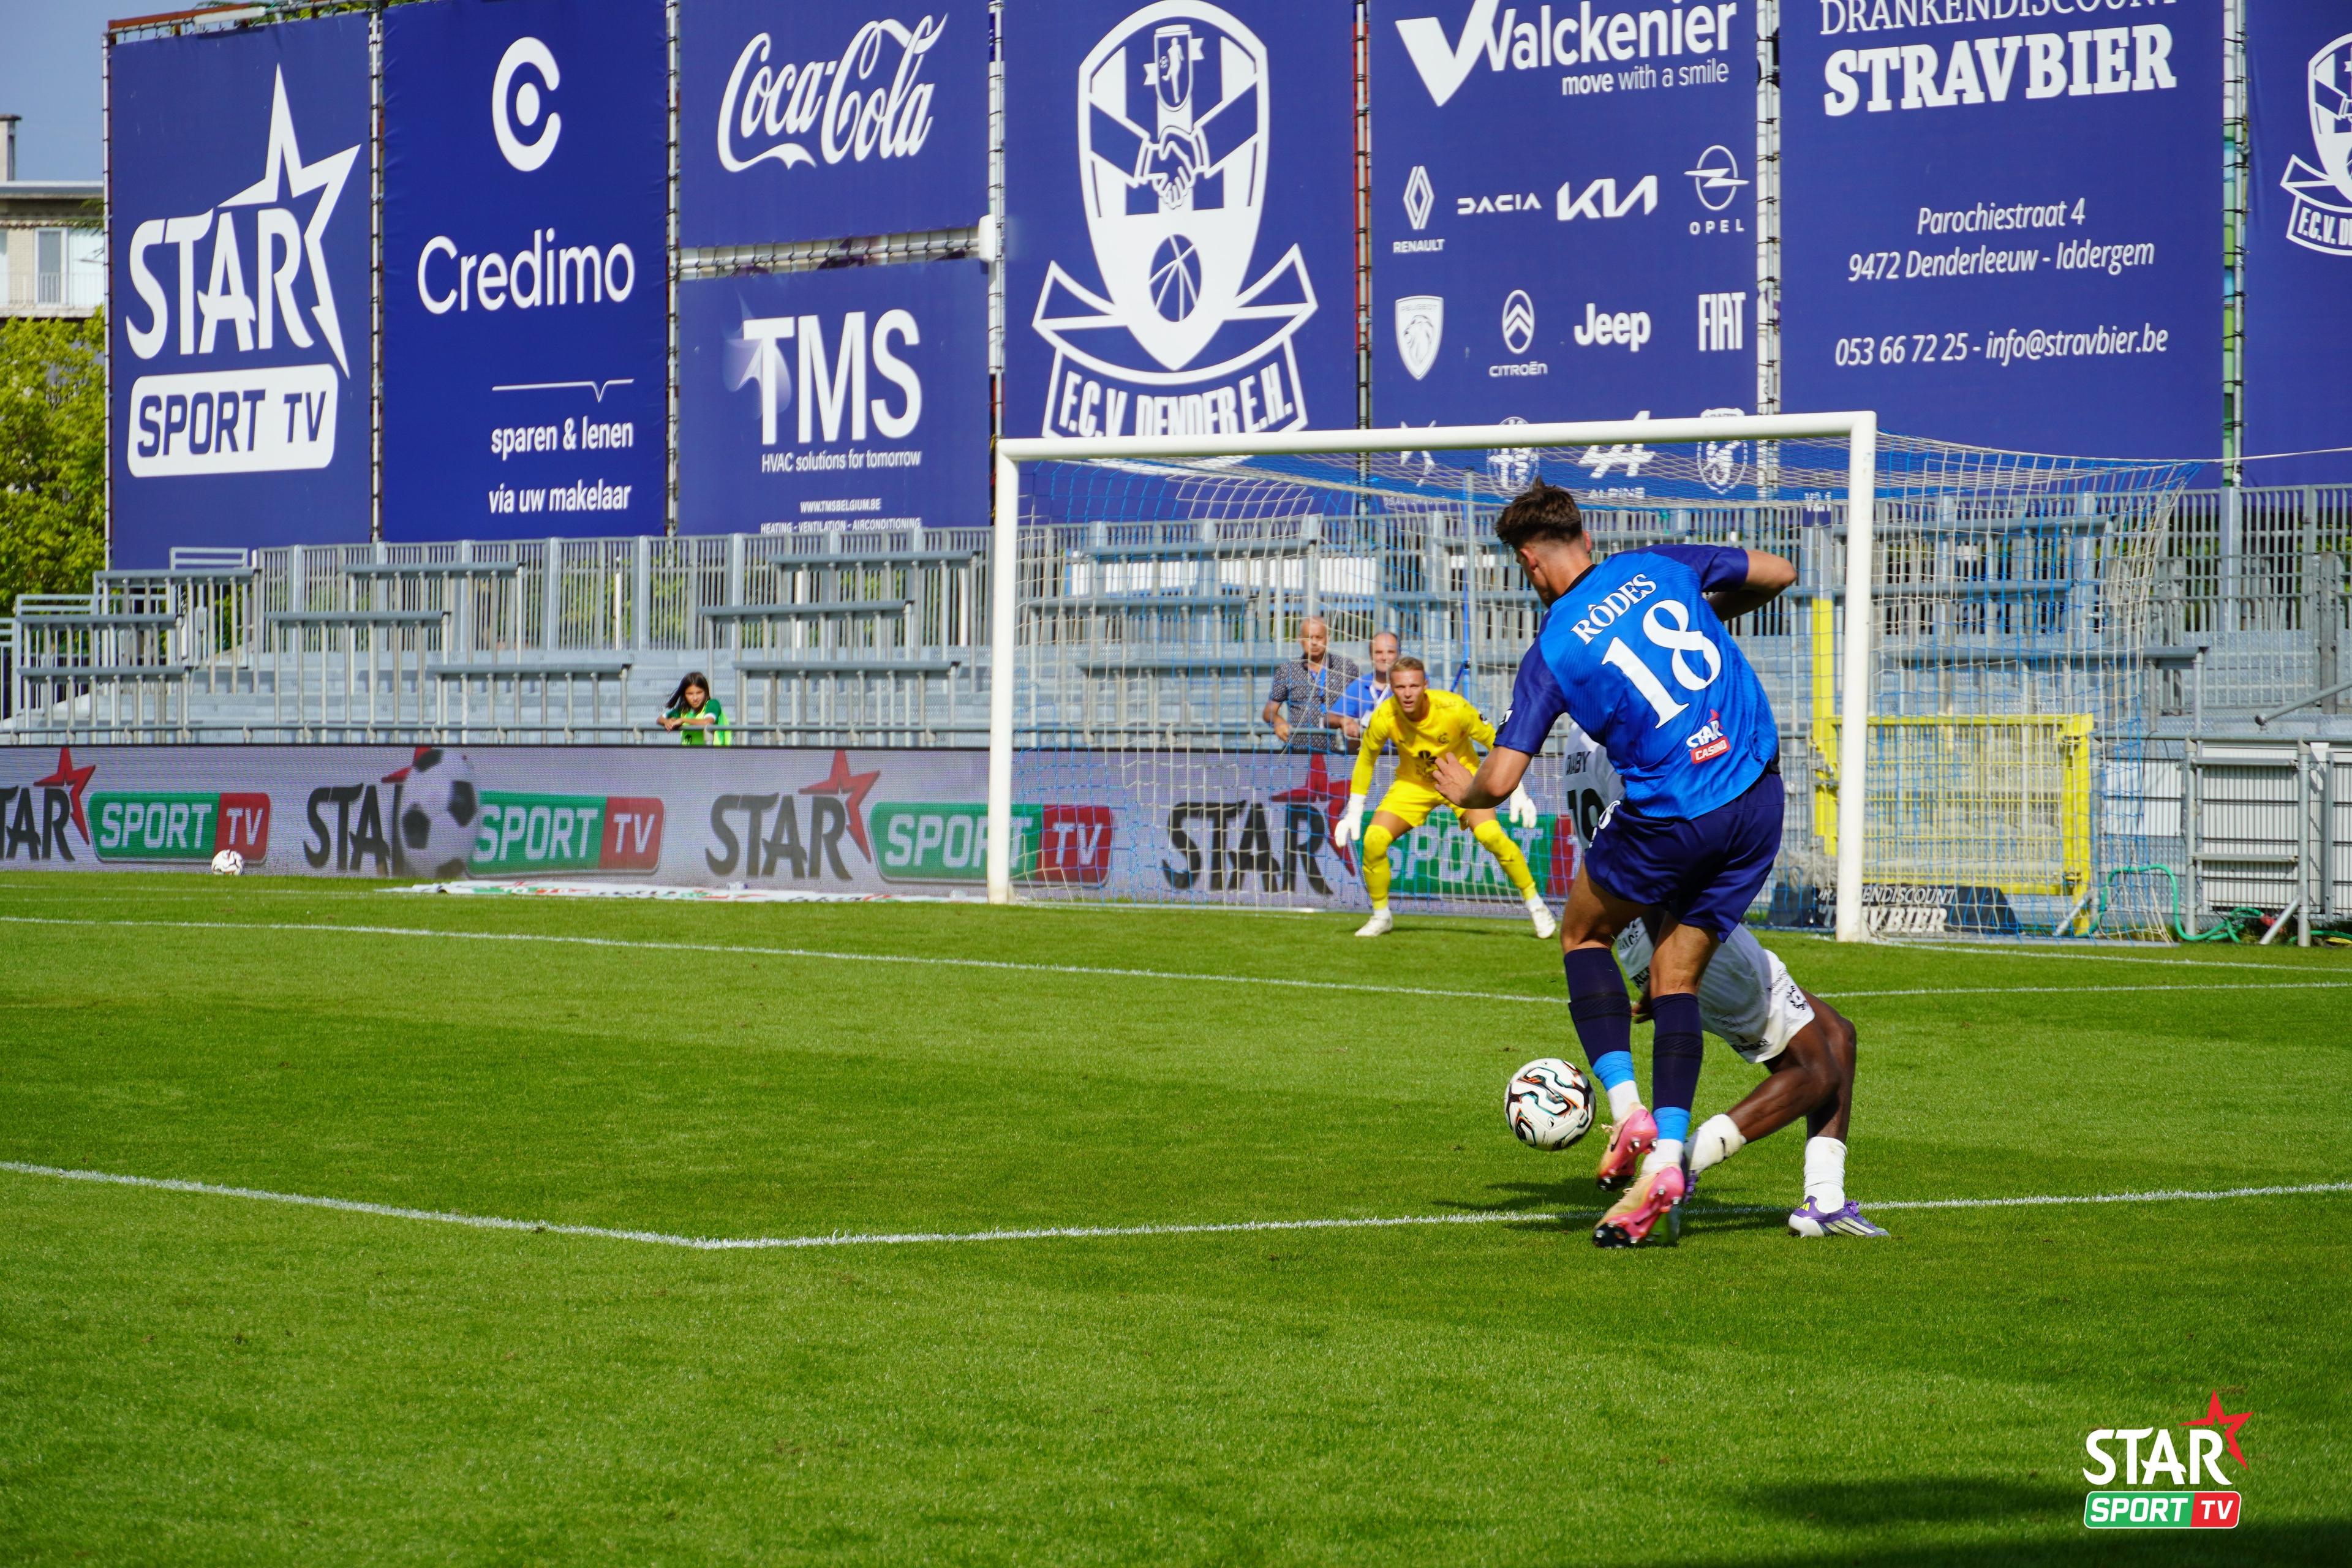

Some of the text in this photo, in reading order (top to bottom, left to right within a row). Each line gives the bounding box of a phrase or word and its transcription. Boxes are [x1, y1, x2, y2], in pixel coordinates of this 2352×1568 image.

[1395, 0, 1737, 107] Walckenier
[1562, 58, 1729, 96] move with a smile
[1824, 24, 2177, 116] STRAVBIER
[718, 13, 948, 172] Coca-Cola
[1457, 192, 1542, 215] DACIA
[1557, 175, 1657, 221] KIA
[1917, 197, 2086, 235] Parochiestraat 4
[1393, 238, 1445, 254] RENAULT
[1689, 219, 1745, 235] OPEL
[126, 208, 315, 360] STAR
[418, 228, 635, 314] Credimo
[1848, 252, 1901, 282] 9472
[1905, 245, 2039, 278] Denderleeuw
[2056, 239, 2155, 276] Iddergem
[1574, 303, 1651, 352] Jeep
[1698, 292, 1746, 352] FIAT
[1835, 337, 1875, 366] 053
[1879, 335, 1907, 364] 66
[1912, 334, 1937, 363] 72
[1941, 333, 1969, 361] 25
[1986, 323, 2168, 366] info@stravbier.be
[743, 309, 922, 445] TMS
[137, 389, 326, 458] SPORT TV
[1059, 371, 1128, 437] F.C.V
[491, 416, 633, 461] sparen & lenen
[761, 448, 921, 473] HVAC solutions for tomorrow
[489, 478, 631, 513] via uw makelaar
[800, 498, 881, 513] WWW.TMSBELGIUM.BE
[760, 522, 792, 534] HEATING
[798, 520, 846, 533] VENTILATION
[852, 518, 922, 530] AIRCONDITIONING
[1601, 600, 1722, 729] 18
[99, 802, 213, 849] SPORT
[226, 808, 263, 845] TV
[304, 782, 655, 876] STA SPORT TV
[705, 793, 853, 881] STAR
[1052, 822, 1102, 867] TV
[1162, 800, 1334, 895] STAR
